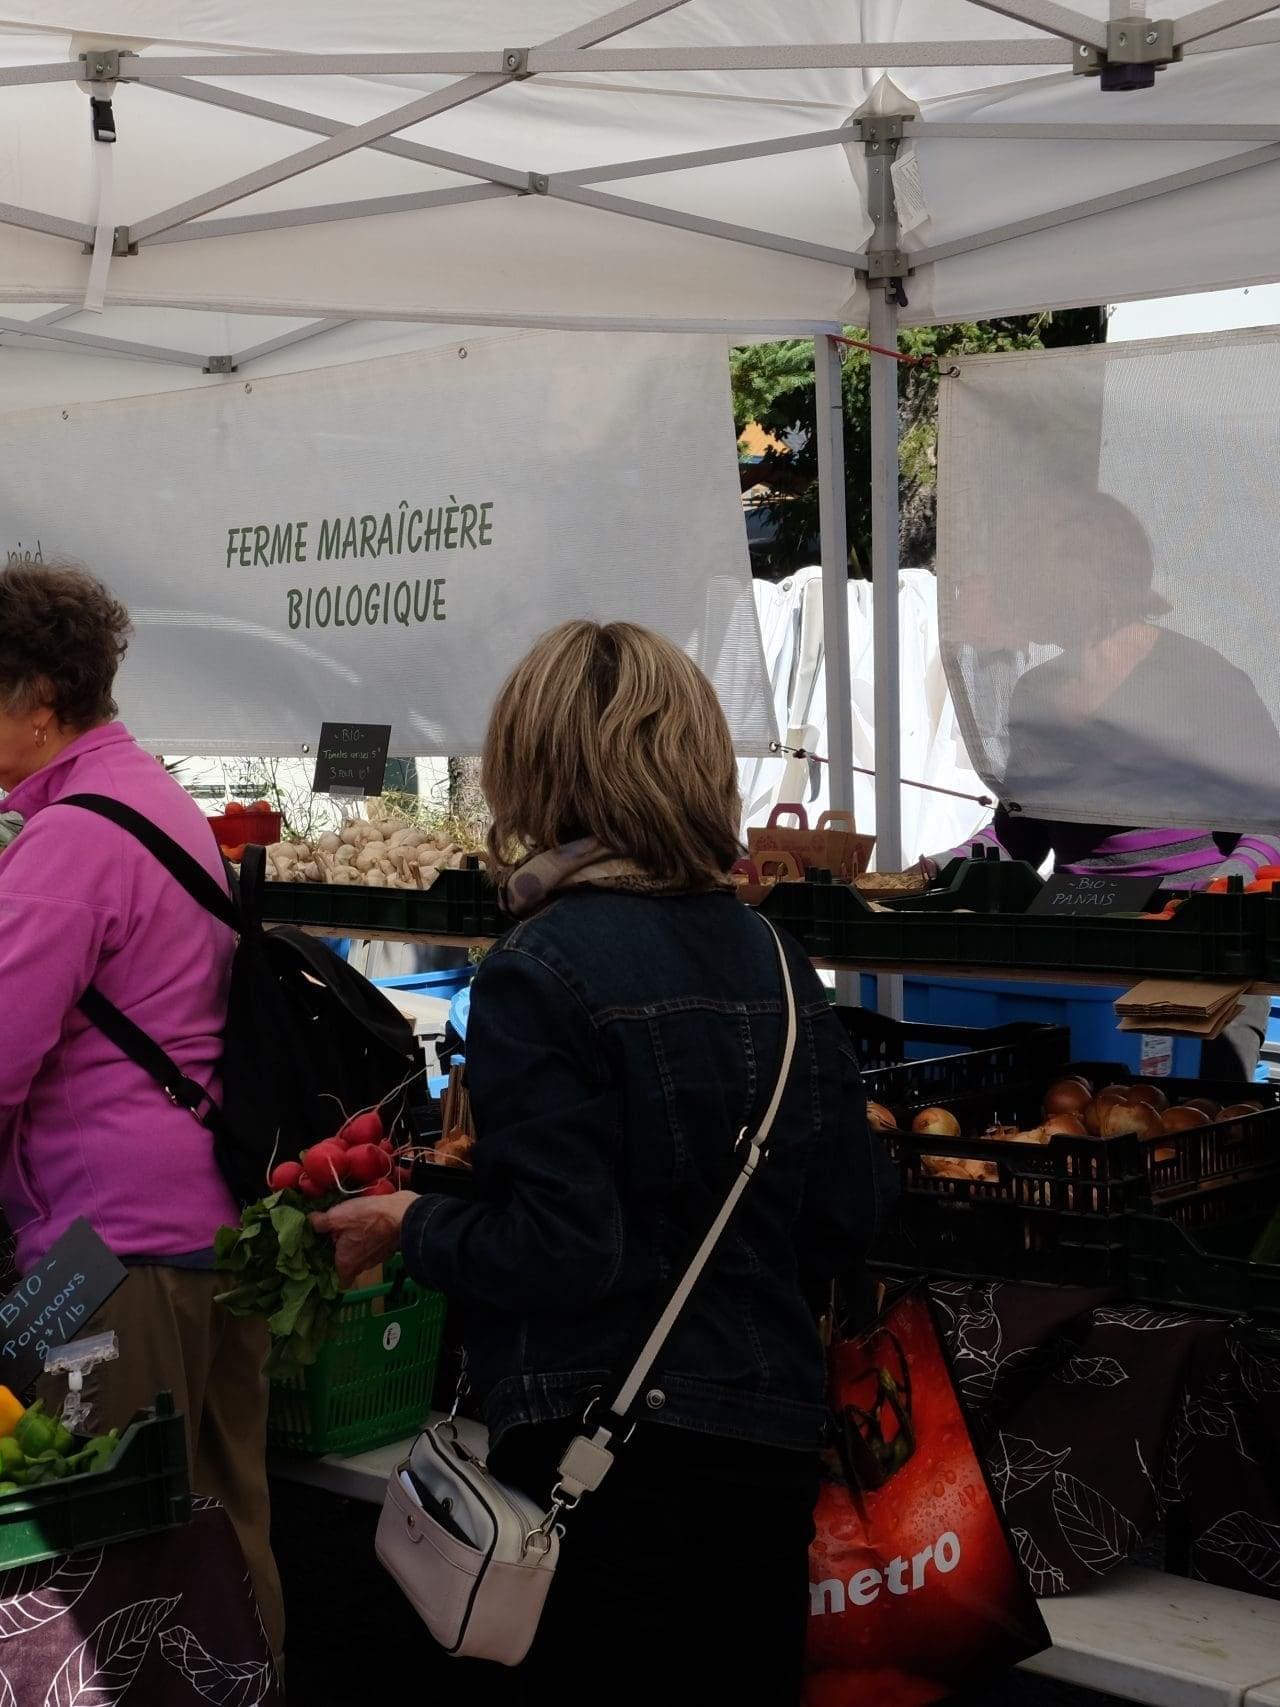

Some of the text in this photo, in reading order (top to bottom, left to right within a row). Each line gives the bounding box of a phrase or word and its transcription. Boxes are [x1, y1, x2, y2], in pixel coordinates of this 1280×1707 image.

[227, 495, 494, 569] FERME MARAÎCHÈRE
[287, 578, 447, 630] BIOLOGIQUE
[1051, 893, 1116, 906] PANAIS
[808, 1531, 961, 1617] metro
